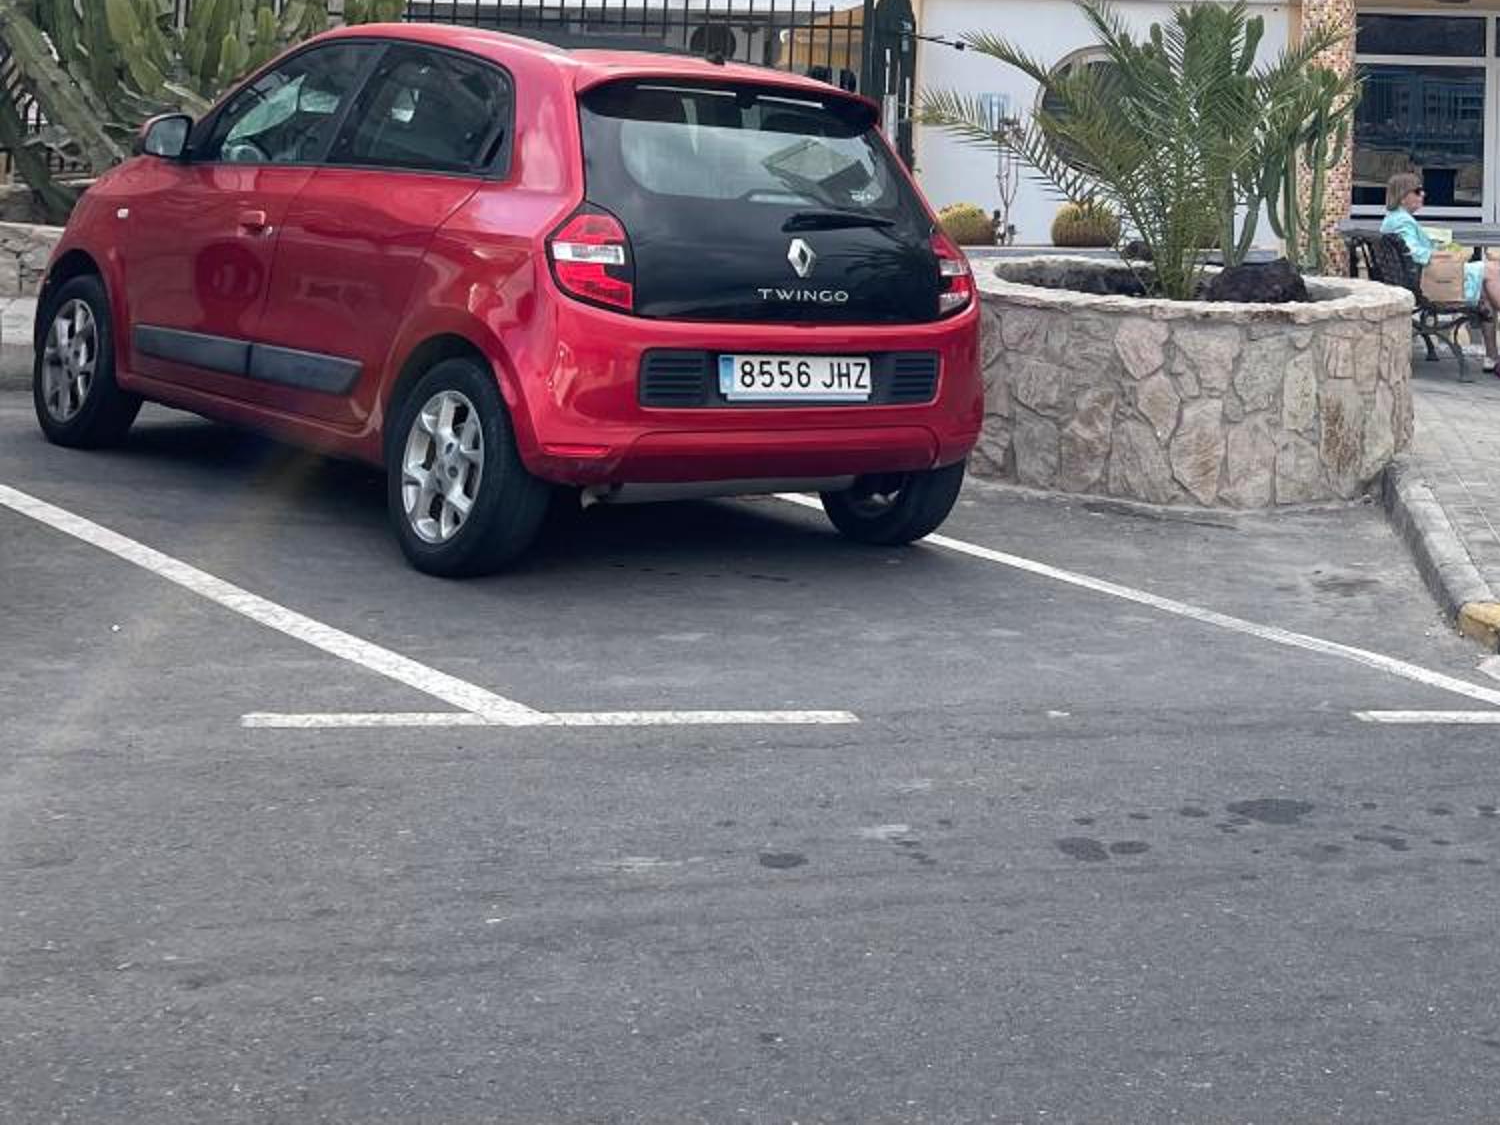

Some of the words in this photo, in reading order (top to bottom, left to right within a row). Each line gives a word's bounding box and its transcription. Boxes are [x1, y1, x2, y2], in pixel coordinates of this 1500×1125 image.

[757, 288, 849, 302] TWINGO
[740, 360, 811, 388] 8556
[822, 362, 868, 389] JHZ
